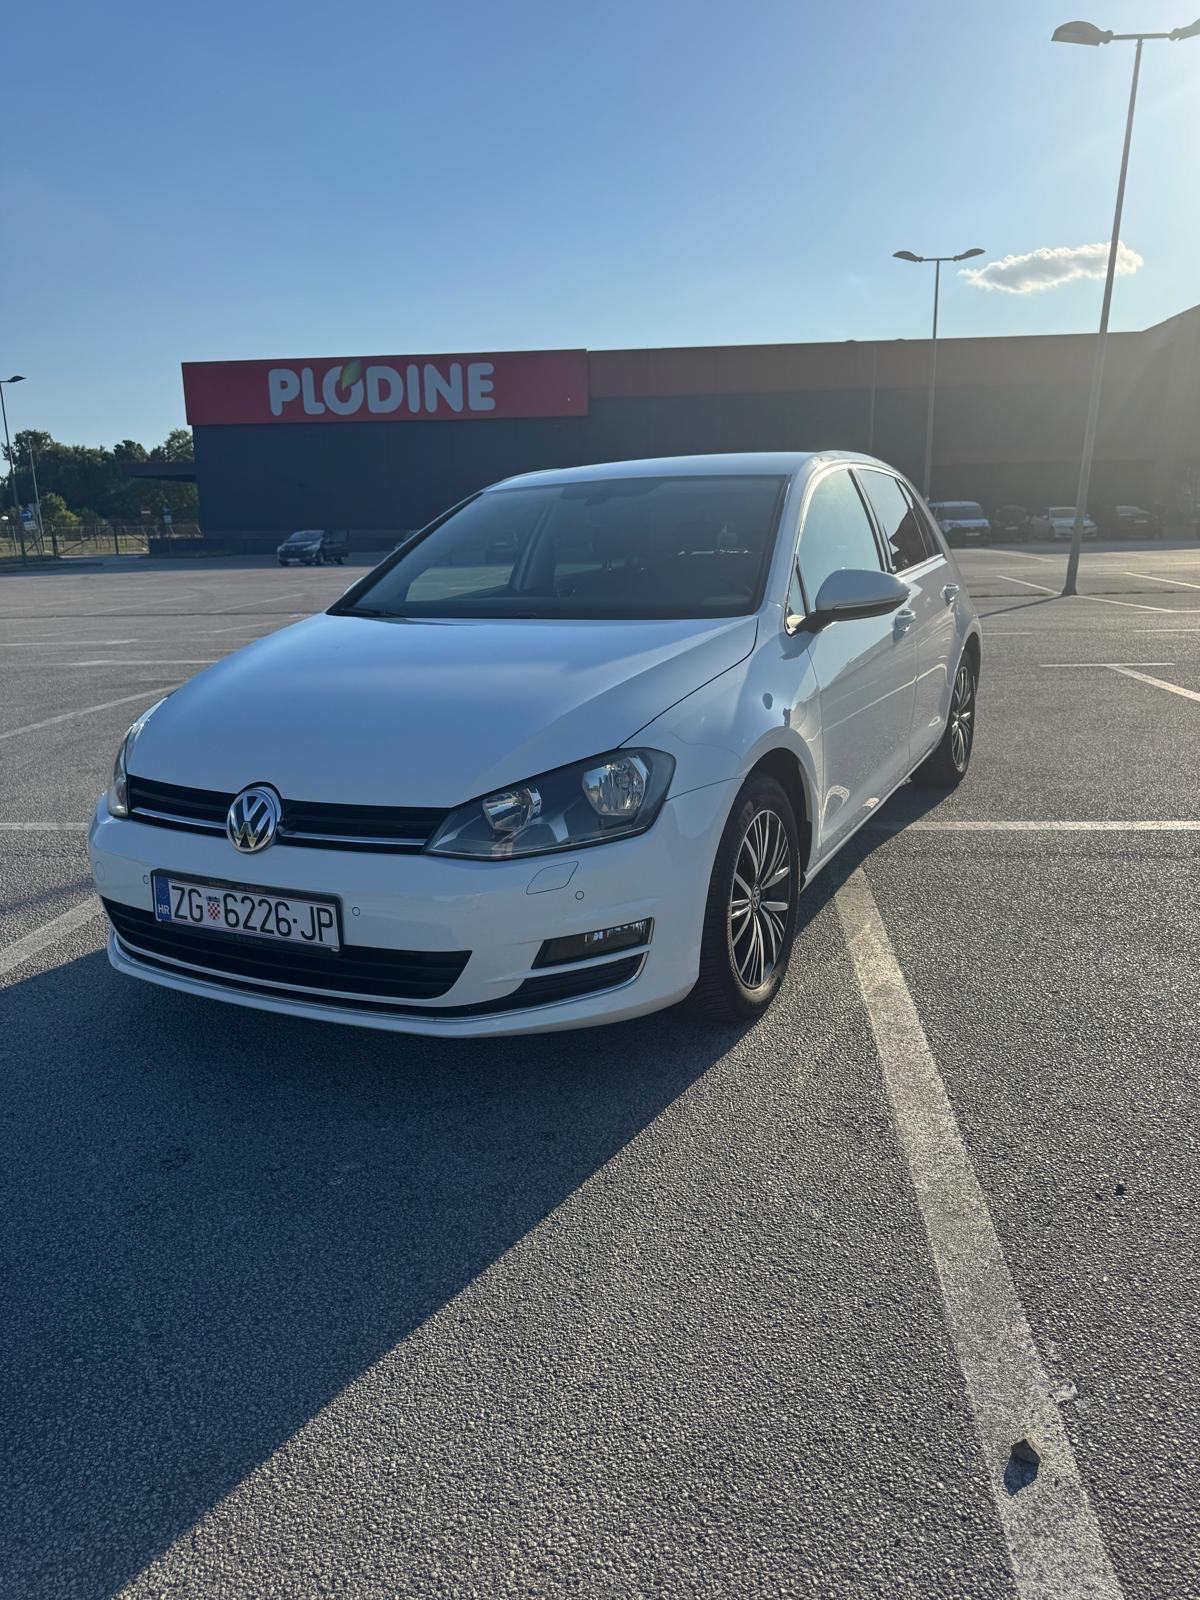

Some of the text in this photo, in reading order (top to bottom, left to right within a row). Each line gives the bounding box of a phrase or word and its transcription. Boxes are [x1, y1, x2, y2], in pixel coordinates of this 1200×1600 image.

[268, 362, 495, 416] PLODINE
[228, 789, 276, 851] VW
[158, 905, 171, 916] HR
[171, 885, 204, 923] ZG
